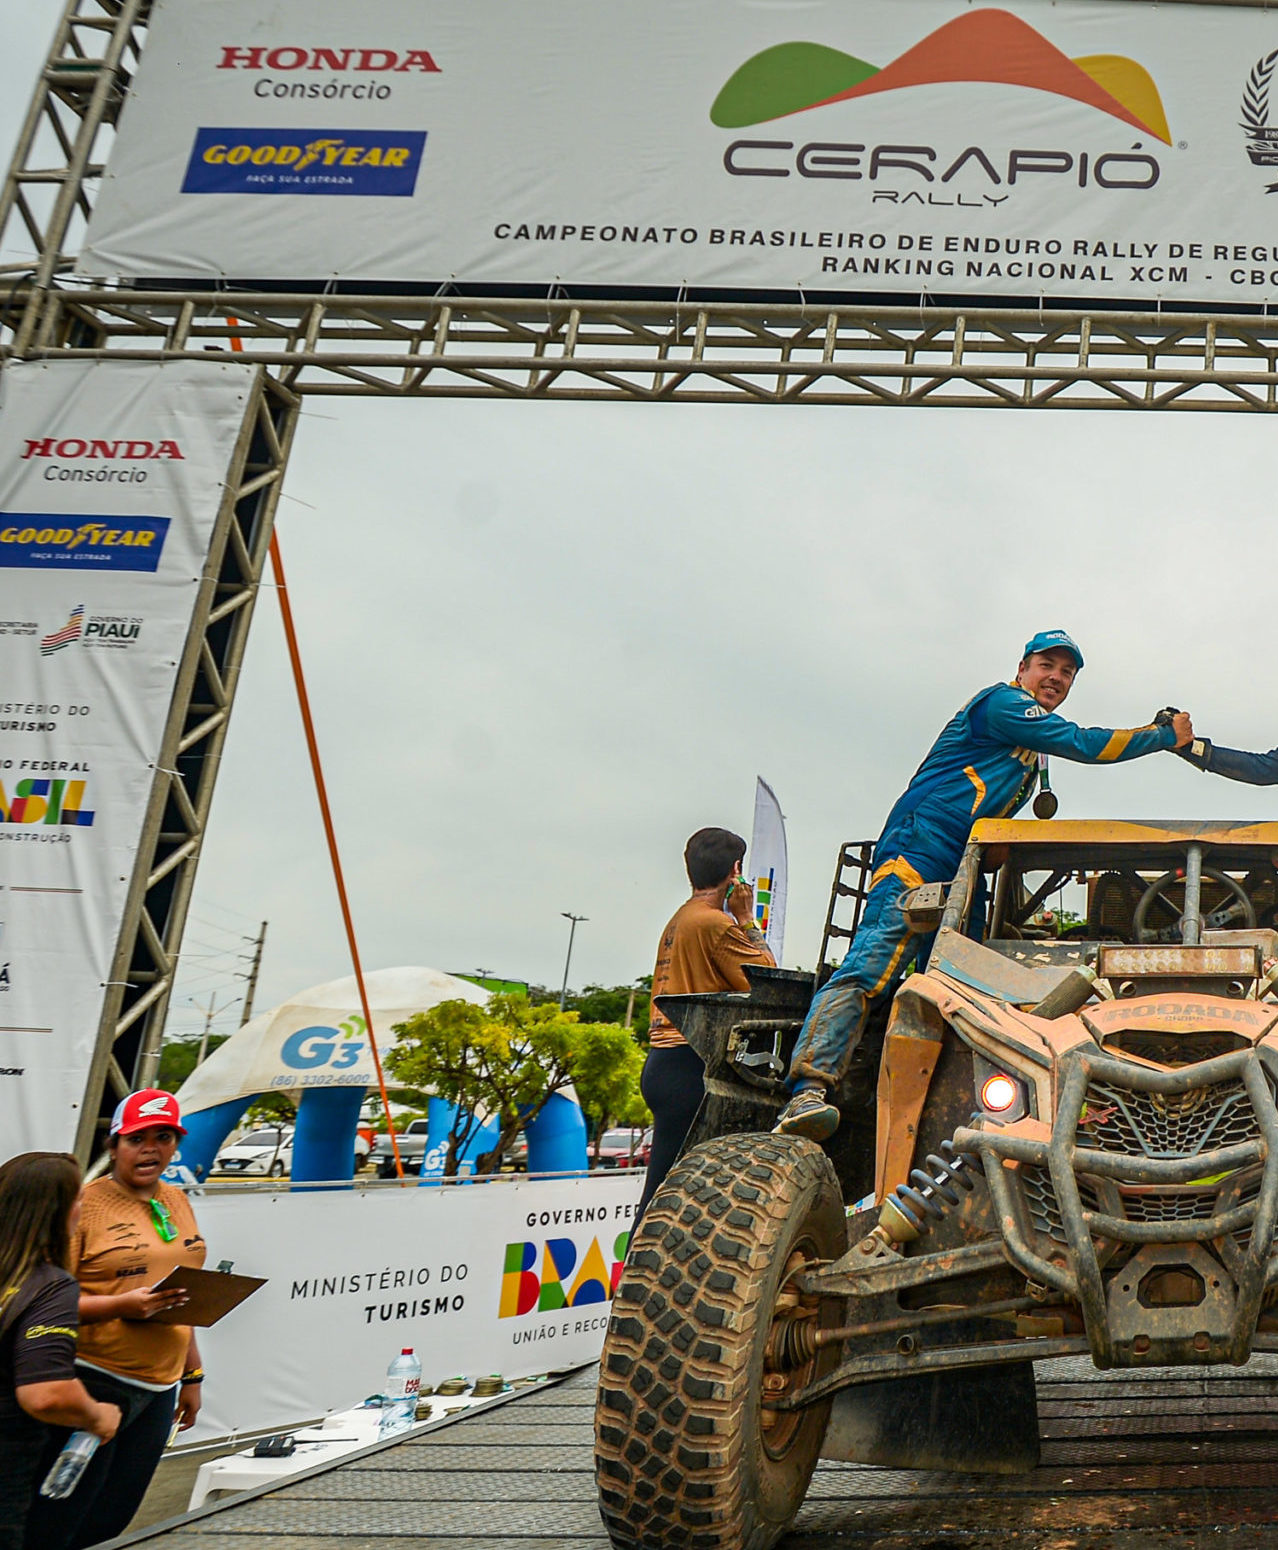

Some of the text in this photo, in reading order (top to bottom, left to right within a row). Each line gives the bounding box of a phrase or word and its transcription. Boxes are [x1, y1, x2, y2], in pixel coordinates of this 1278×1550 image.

[215, 46, 443, 73] HONDA
[253, 78, 392, 101] Consórcio
[202, 139, 411, 171] GOODYEAR
[722, 139, 1161, 189] CERAPIÓ
[303, 175, 354, 185] ESTRADA
[872, 190, 1010, 208] RALLY
[493, 223, 700, 245] CAMPEONATO
[708, 228, 888, 251] BRASILEIRO
[897, 235, 934, 253] DE
[942, 236, 1062, 256] ENDURO
[1072, 239, 1160, 259] RALLY
[1168, 242, 1203, 260] DE
[820, 255, 956, 278] RANKING
[965, 260, 1115, 283] NACIONAL
[1128, 264, 1189, 284] XCM
[20, 437, 187, 460] HONDA
[43, 465, 148, 483] Consórcio
[84, 622, 142, 639] PIAUÍ
[68, 705, 90, 716] DO
[19, 760, 91, 772] FEDERAL
[1103, 1003, 1260, 1026] RODADA
[281, 1026, 364, 1070] G3
[270, 1075, 297, 1088] (86)
[526, 1206, 608, 1228] GOVERNO
[290, 1263, 469, 1300] MINISTÉRIO DO
[364, 1294, 466, 1324] TURISMO
[512, 1324, 557, 1345] UNIÃO
[561, 1323, 570, 1336] E
